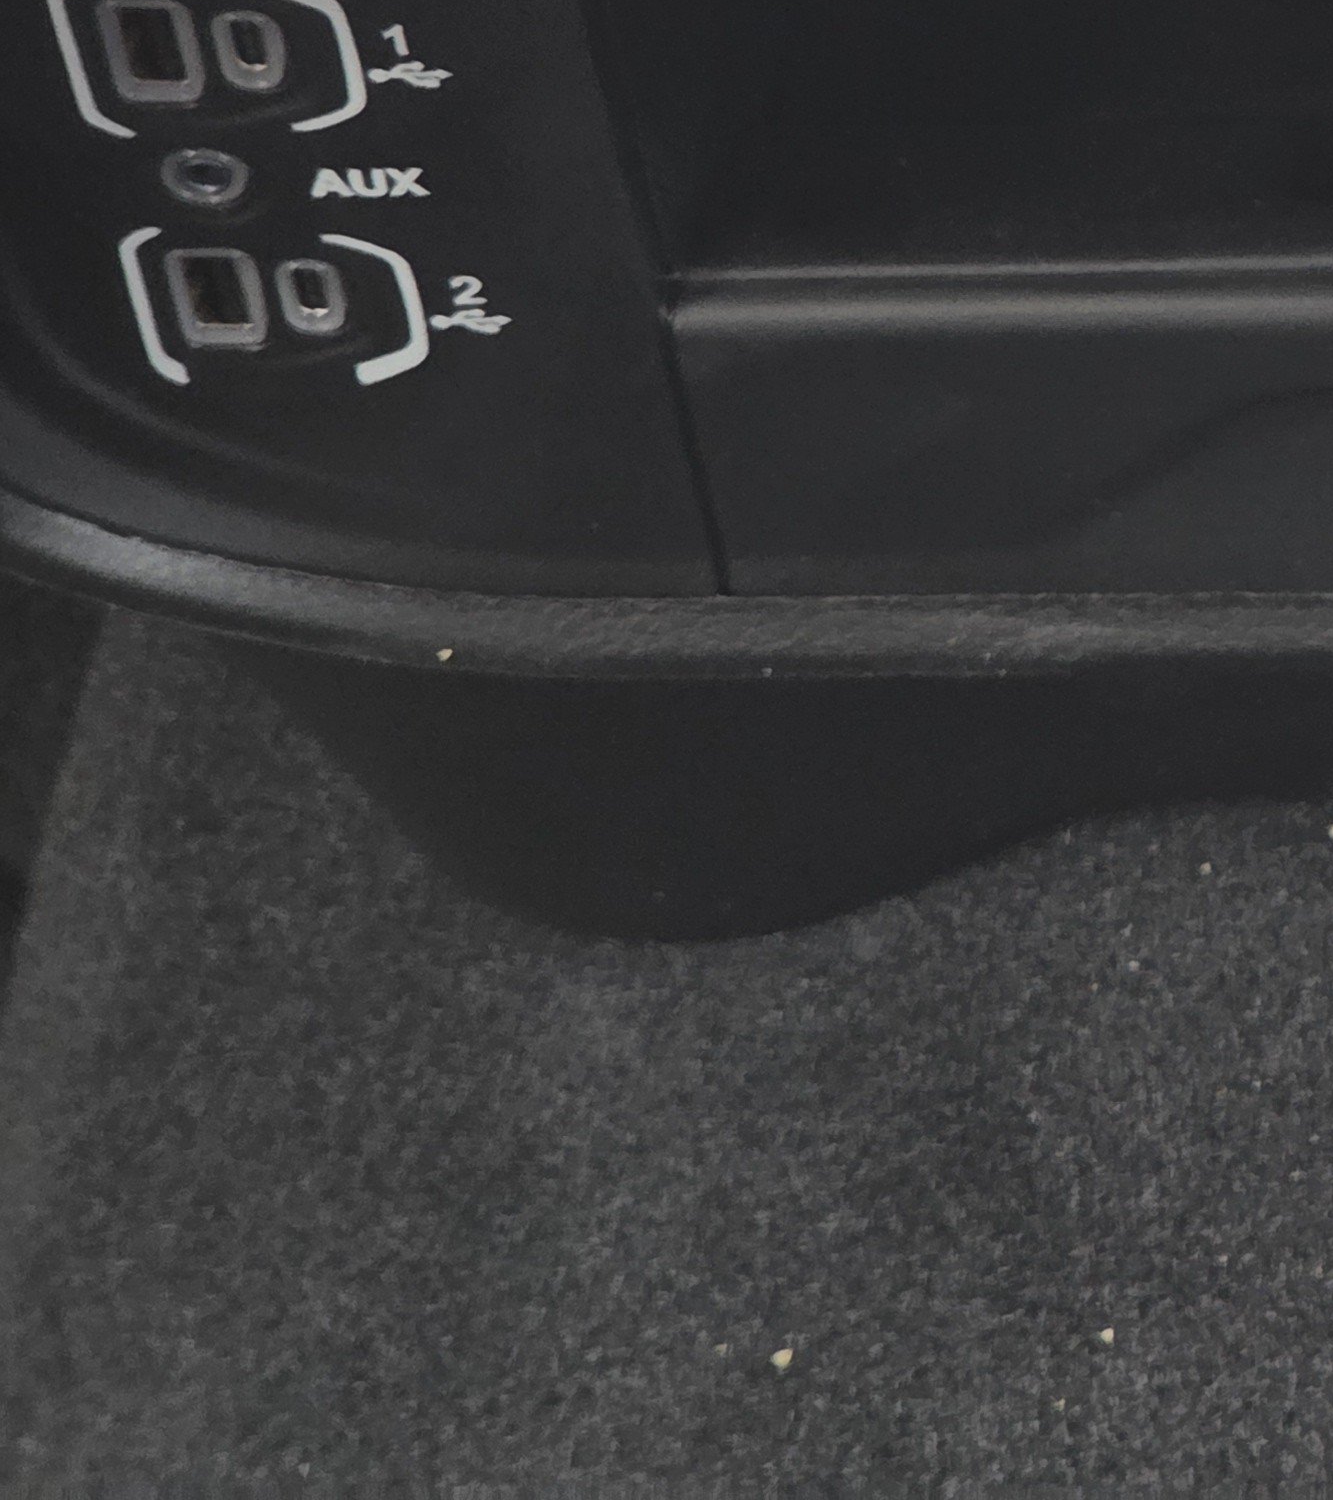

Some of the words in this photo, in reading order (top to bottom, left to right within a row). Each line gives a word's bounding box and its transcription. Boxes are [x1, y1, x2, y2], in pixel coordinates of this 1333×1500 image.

[382, 23, 410, 57] 1
[310, 167, 431, 198] AUX
[449, 275, 488, 306] 2
